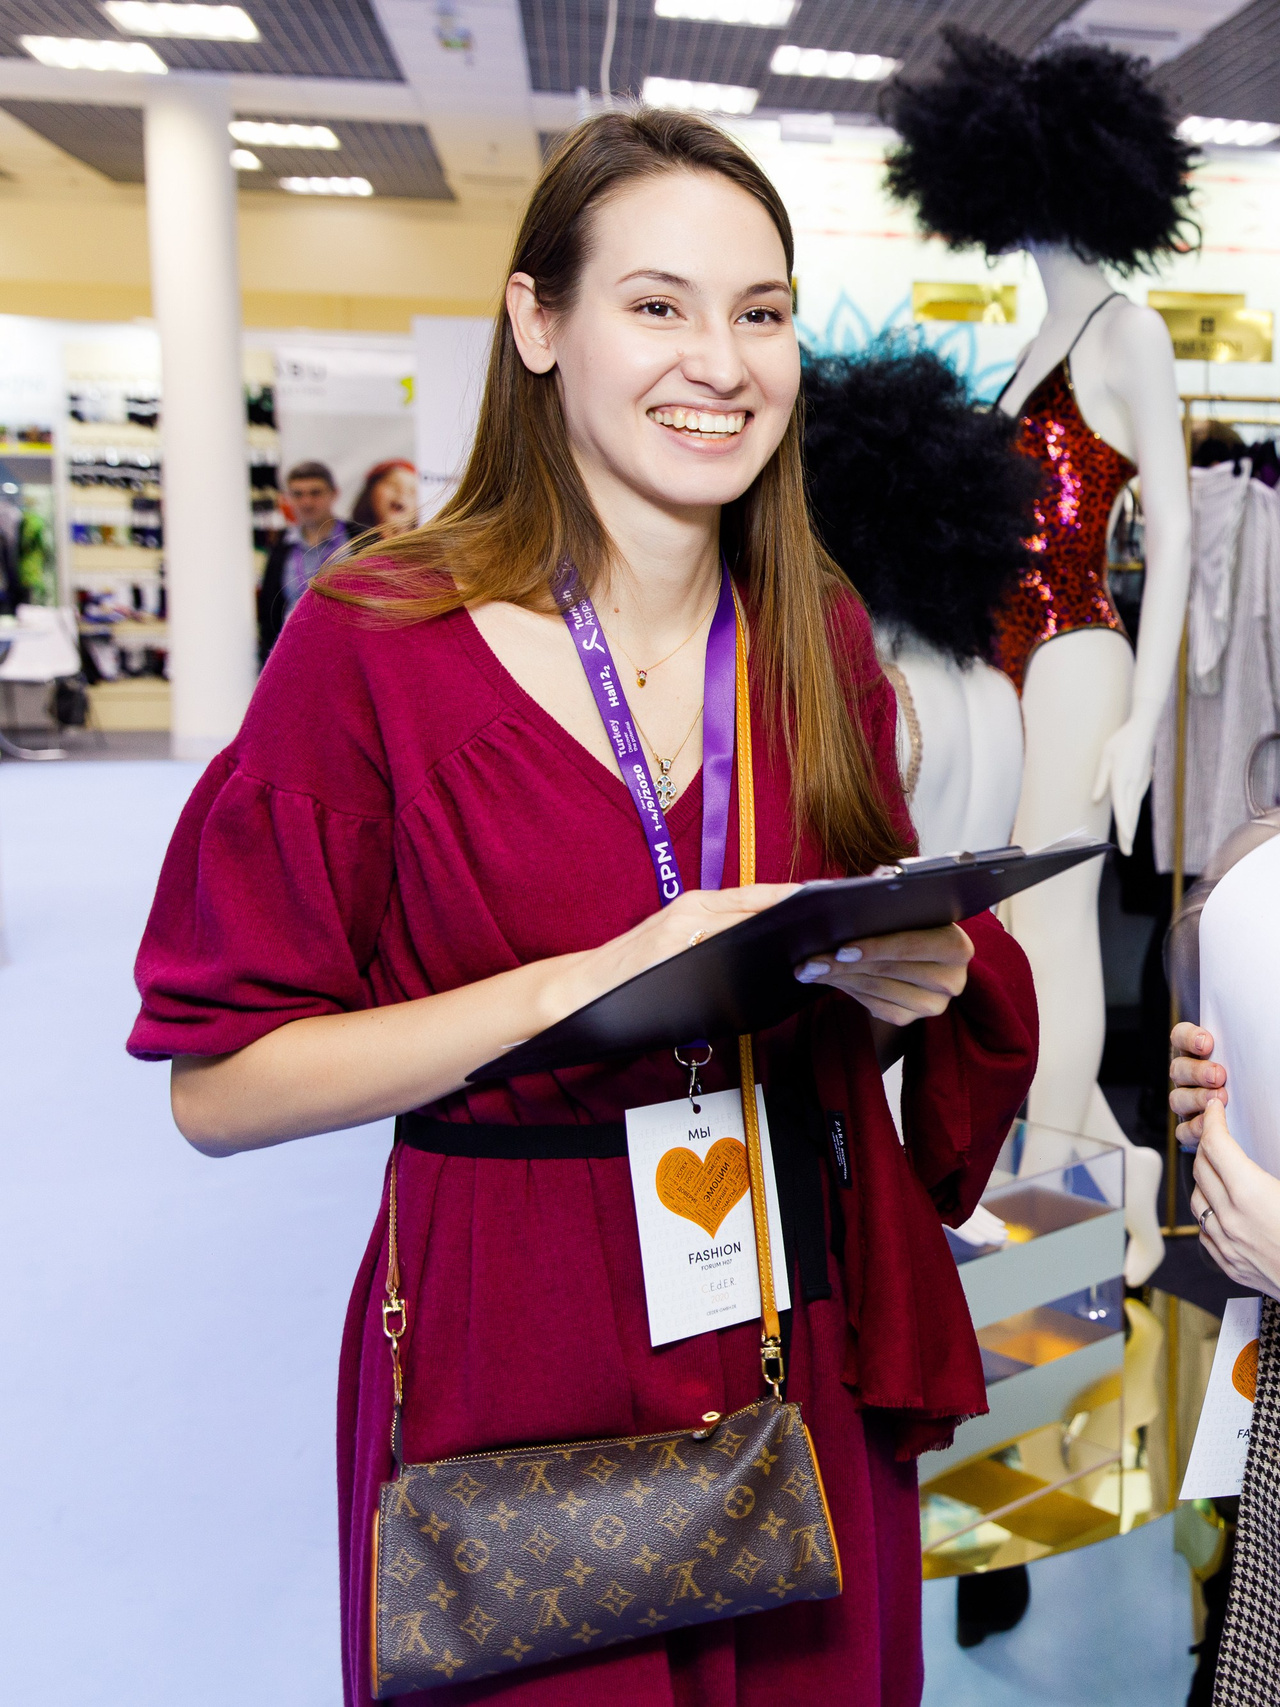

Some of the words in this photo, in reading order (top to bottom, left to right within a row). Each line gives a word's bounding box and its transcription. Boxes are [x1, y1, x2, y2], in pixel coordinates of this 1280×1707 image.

[562, 590, 584, 630] Turksh
[602, 680, 620, 708] Hall
[609, 719, 627, 758] Turkey
[633, 764, 662, 832] 1-4/9/2020
[654, 841, 680, 899] CPM
[688, 1126, 711, 1141] МЫ
[834, 1120, 844, 1146] ZARA
[676, 1161, 688, 1178] УСПЕХ
[707, 1154, 721, 1176] ВМЕСТЕ
[686, 1171, 695, 1184] РОСТ
[703, 1162, 730, 1202] ЭМОЦИИ
[721, 1188, 737, 1211] СЧАСТЬЕ
[688, 1241, 742, 1265] FASHION
[701, 1261, 721, 1271] FORUM
[711, 1292, 729, 1304] 2020
